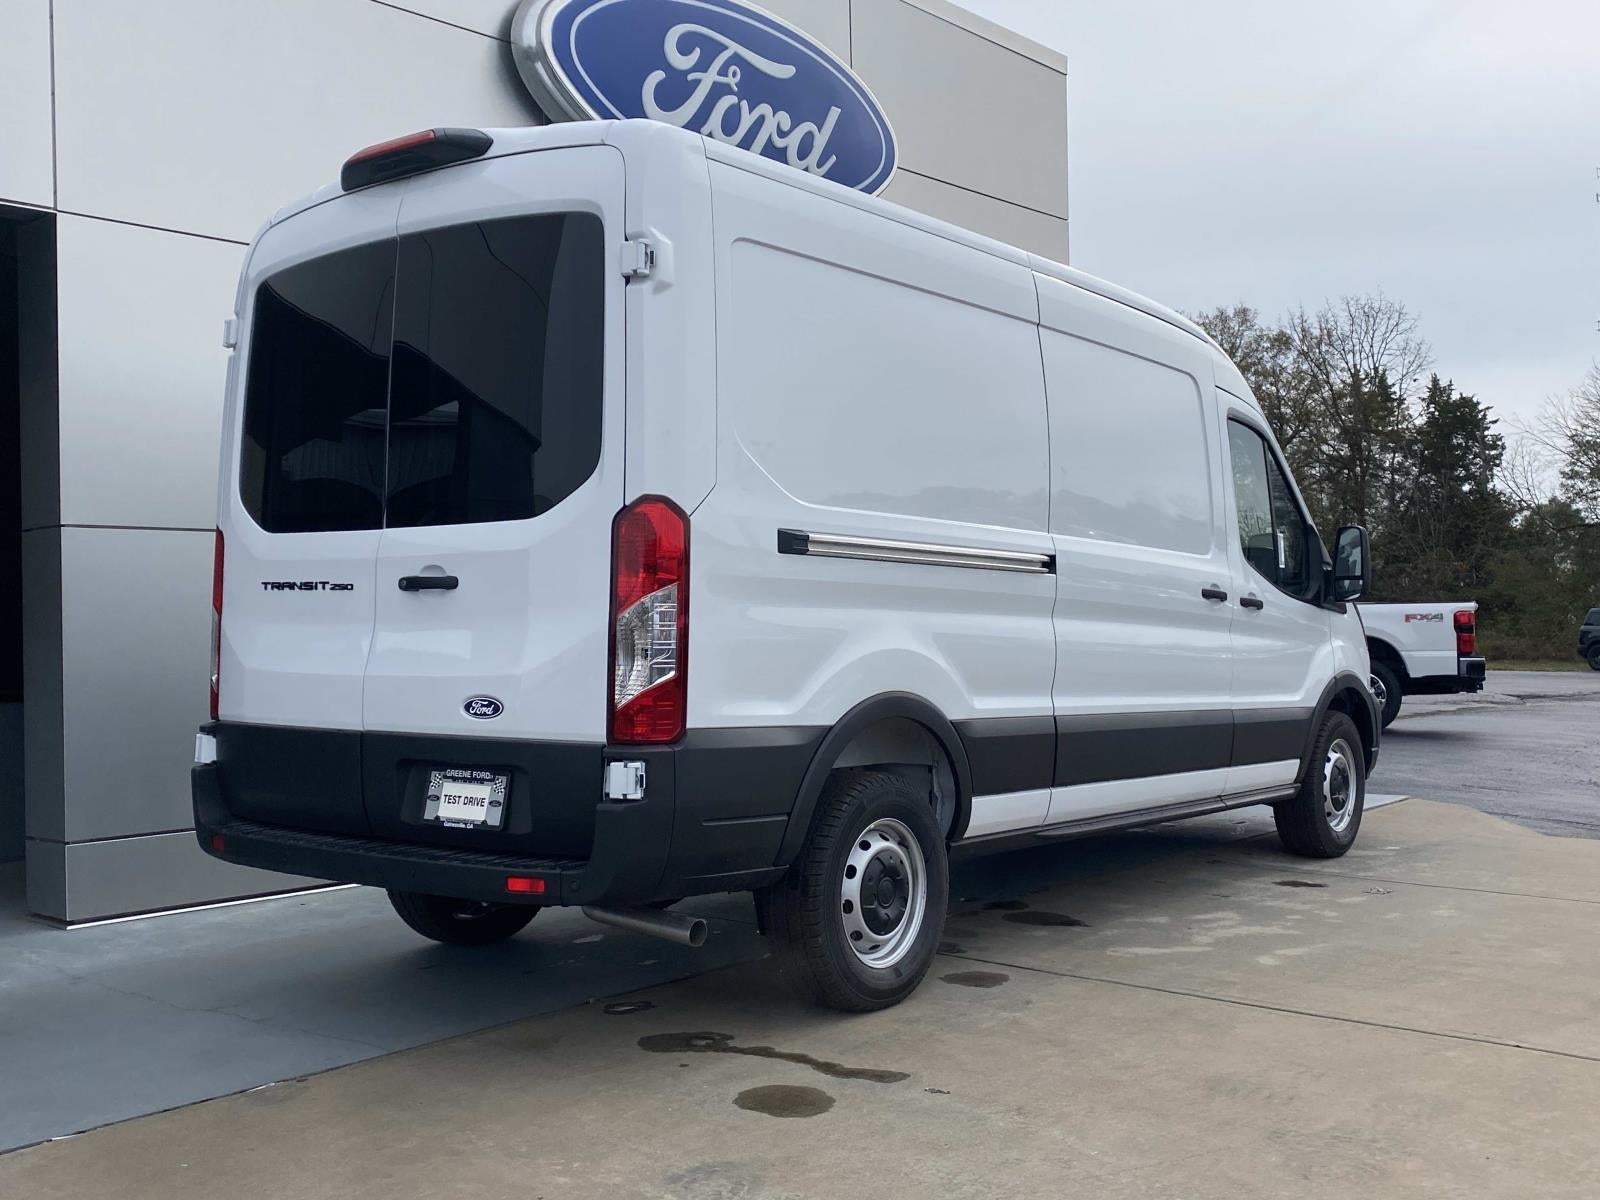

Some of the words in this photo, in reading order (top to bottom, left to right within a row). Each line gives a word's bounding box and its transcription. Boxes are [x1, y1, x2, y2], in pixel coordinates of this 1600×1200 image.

[641, 23, 842, 178] Ford
[261, 581, 330, 591] TRANSIT
[1405, 613, 1444, 623] FX4
[469, 700, 495, 715] Ford
[446, 769, 472, 778] GREENE
[472, 771, 491, 779] FORD
[443, 794, 462, 805] TEST
[463, 796, 486, 807] DRIVE
